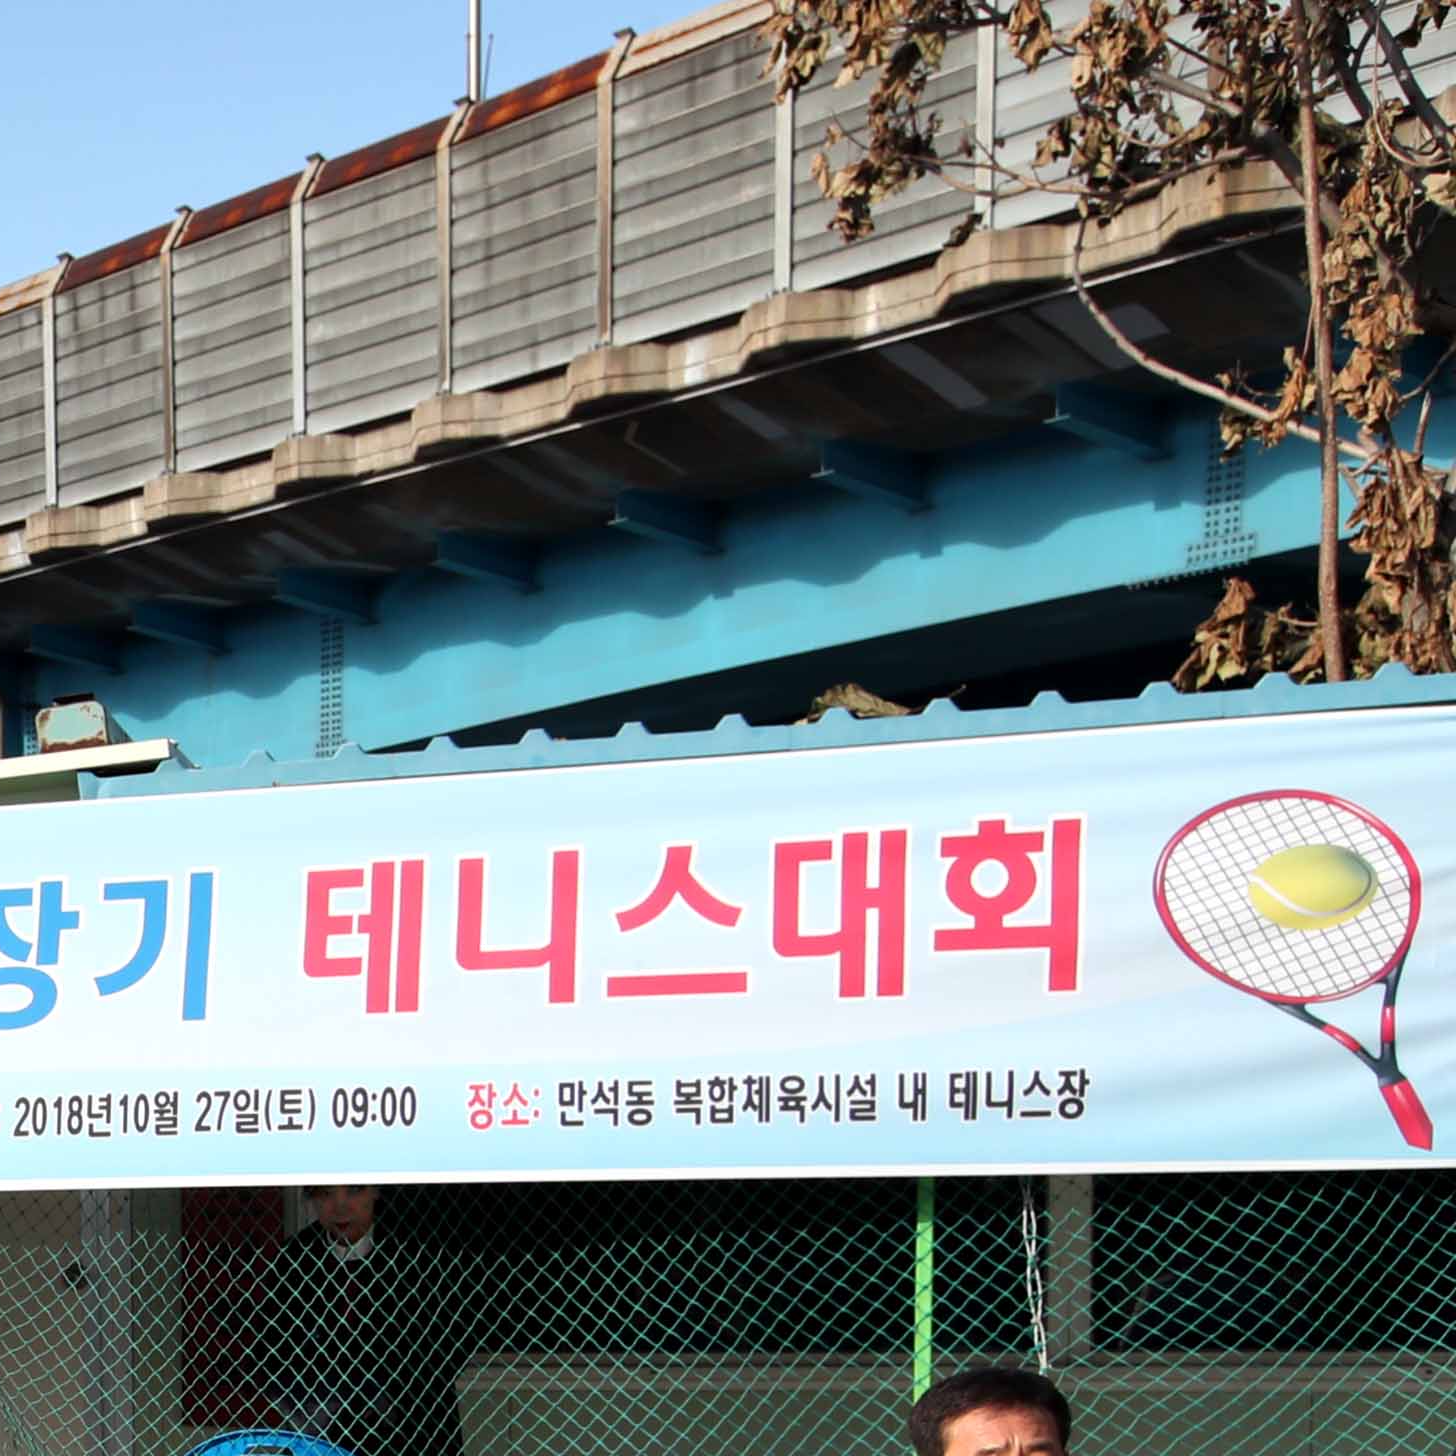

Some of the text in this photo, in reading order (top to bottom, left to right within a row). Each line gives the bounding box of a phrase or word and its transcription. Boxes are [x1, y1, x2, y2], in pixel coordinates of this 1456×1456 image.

[302, 818, 1083, 1014] 테니스대회
[194, 1087, 317, 1134] 27일(토)
[331, 1086, 418, 1128] 09:00
[466, 1083, 541, 1131] 장소:
[558, 1078, 656, 1127] 만석동
[673, 1073, 878, 1125] 복합체육시설
[897, 1071, 928, 1122] 내
[949, 1068, 1091, 1121] 테니스장
